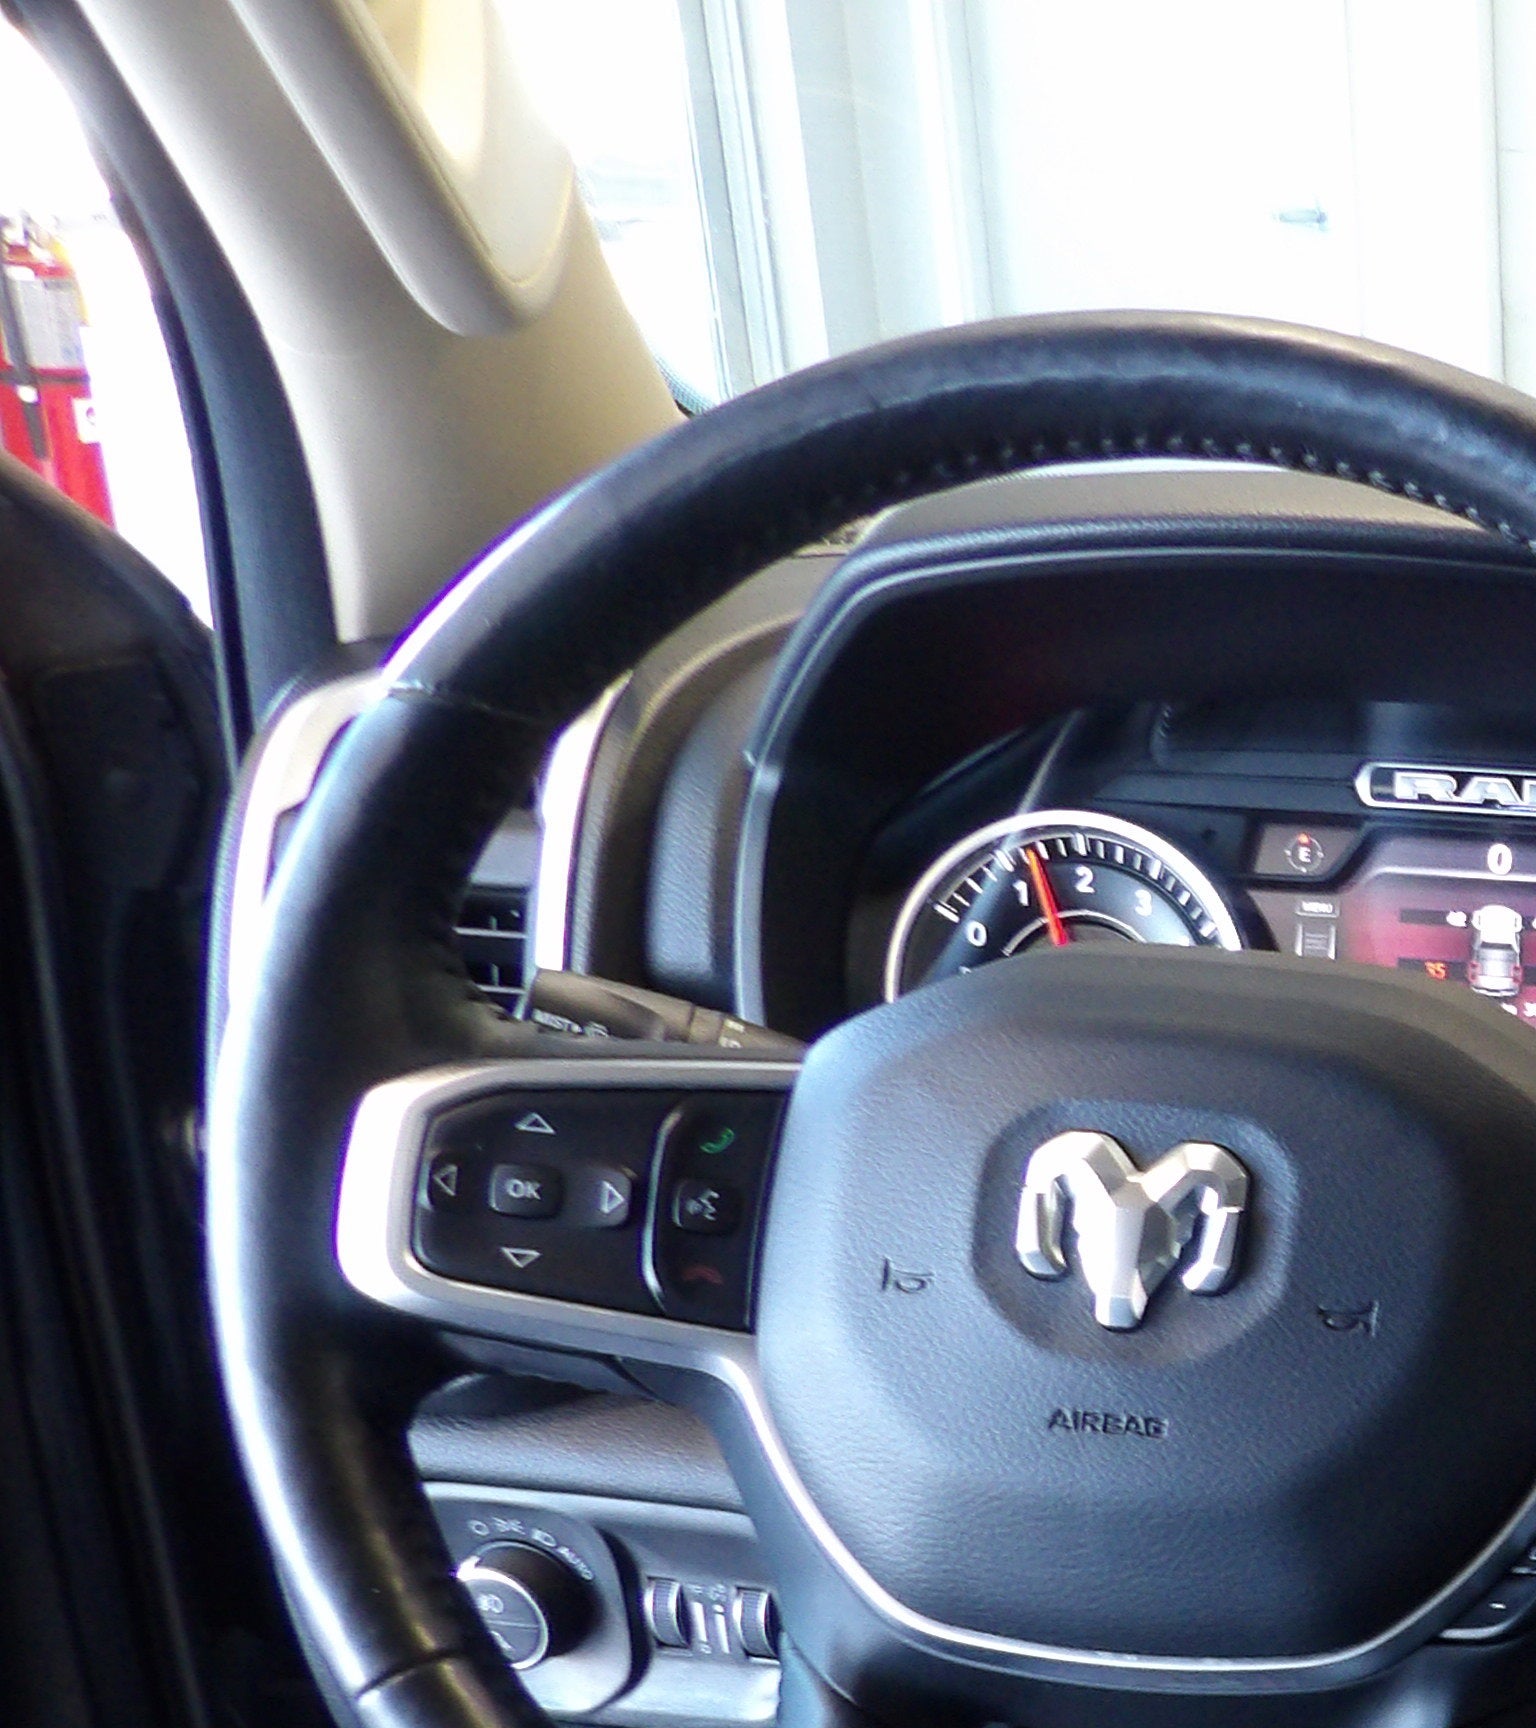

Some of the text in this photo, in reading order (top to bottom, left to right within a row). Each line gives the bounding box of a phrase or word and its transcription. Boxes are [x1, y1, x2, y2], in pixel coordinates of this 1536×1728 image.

[1487, 843, 1512, 876] 0
[1011, 880, 1029, 907] 1
[1075, 865, 1095, 894] 2
[1133, 889, 1152, 917] 3
[967, 921, 988, 947] 0
[506, 1178, 541, 1201] OK
[1048, 1408, 1168, 1439] AIRBAG
